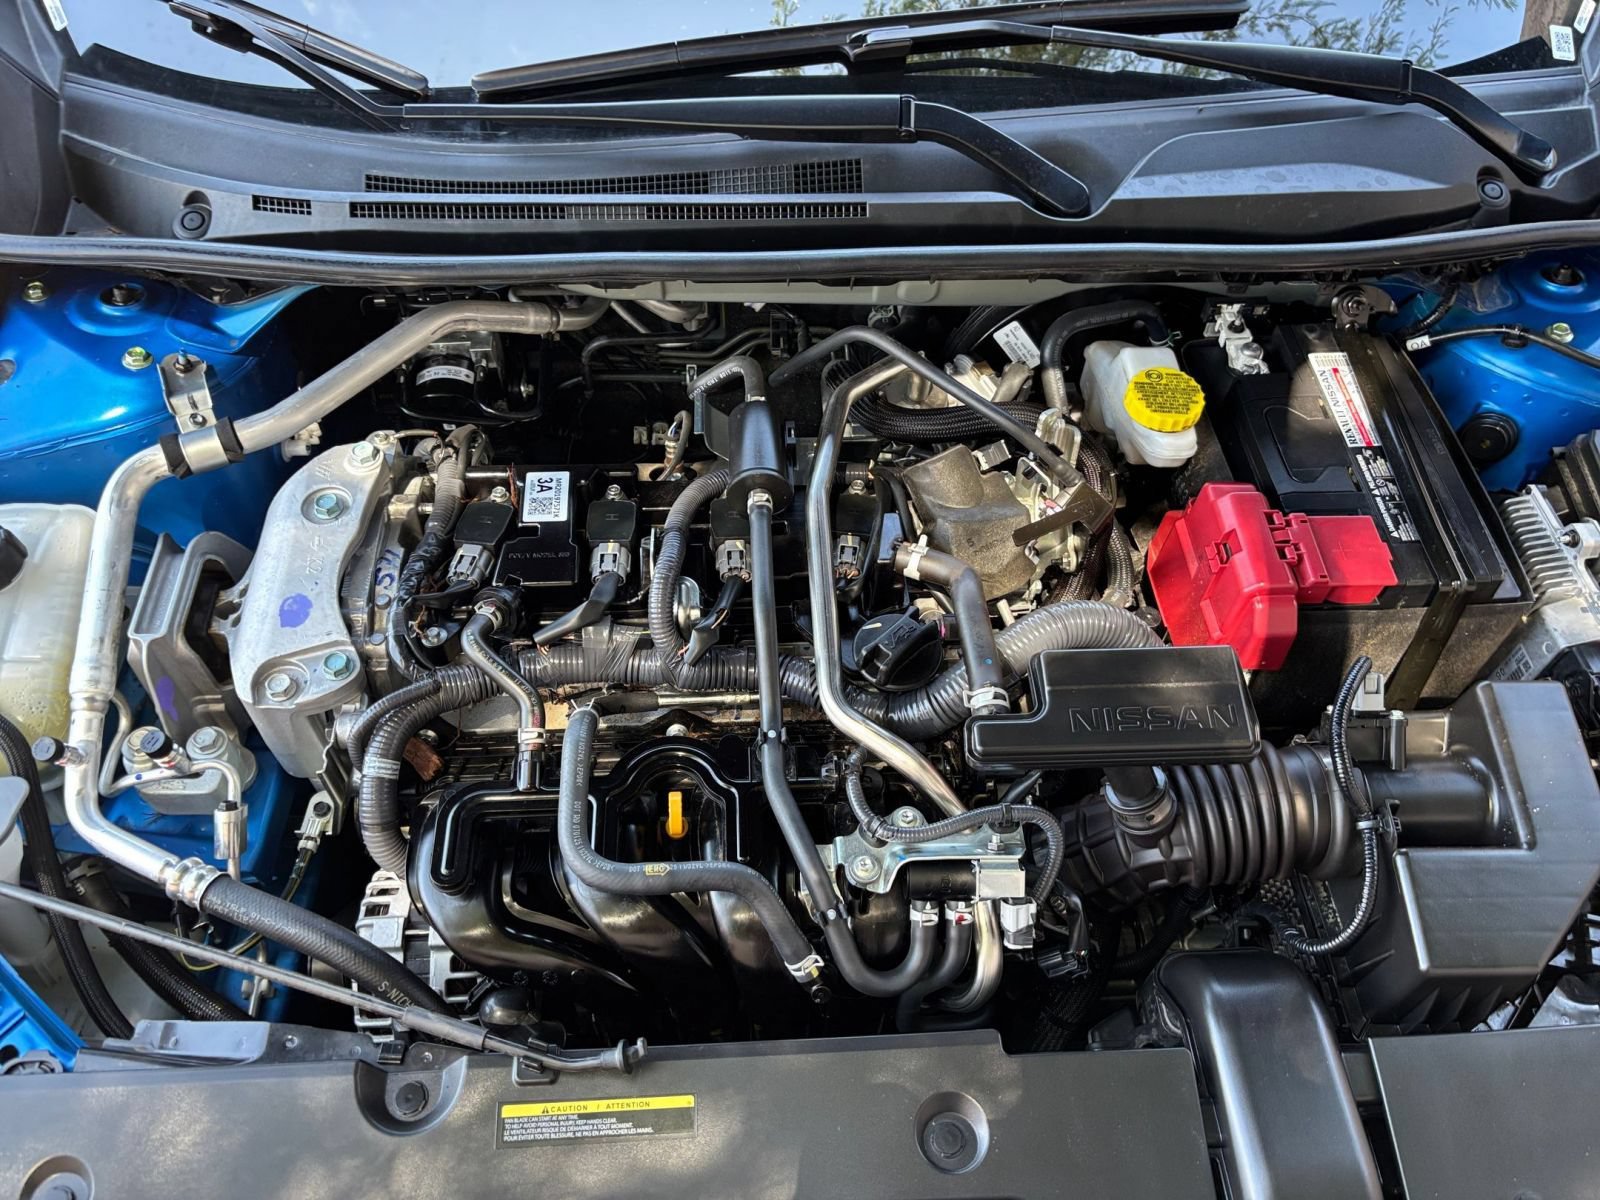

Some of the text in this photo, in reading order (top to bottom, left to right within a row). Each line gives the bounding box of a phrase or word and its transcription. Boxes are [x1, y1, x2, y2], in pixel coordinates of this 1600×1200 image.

[1318, 369, 1342, 407] NISSAN
[1336, 409, 1359, 445] RENAULT
[536, 477, 553, 493] 3A
[1069, 704, 1241, 733] NISSAN
[550, 1105, 588, 1113] CAUTION
[606, 1101, 651, 1110] ATTENTION
